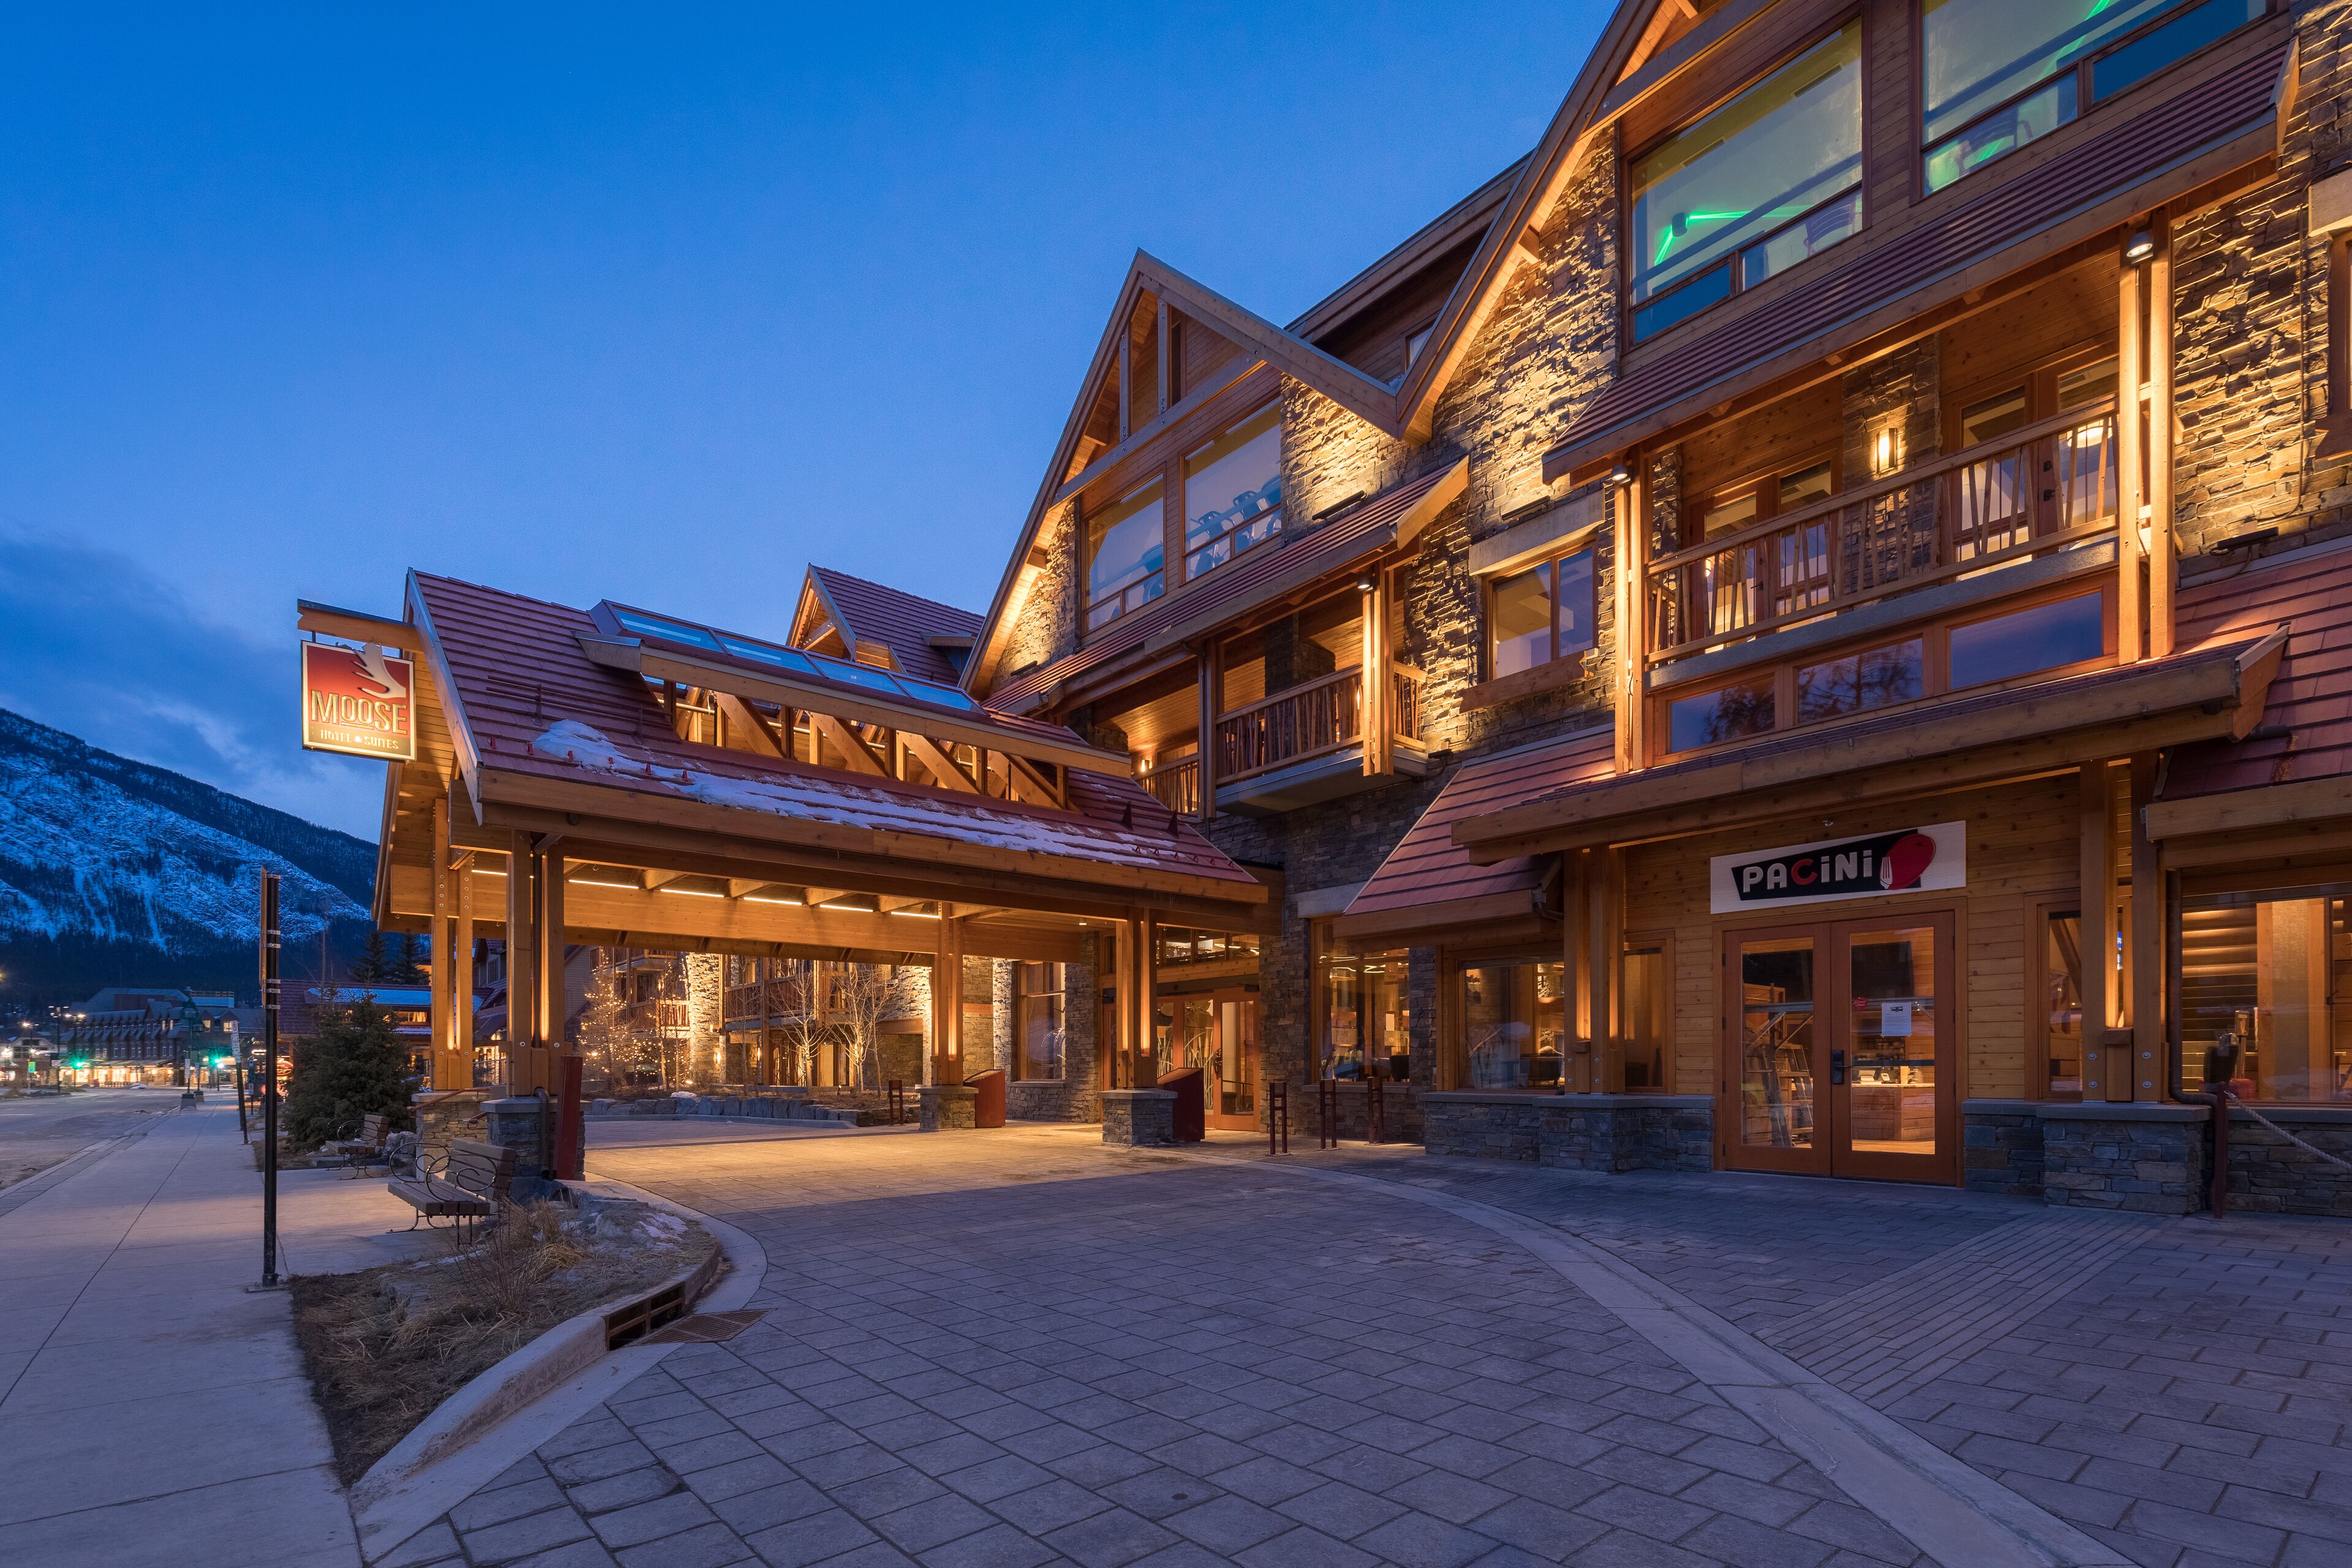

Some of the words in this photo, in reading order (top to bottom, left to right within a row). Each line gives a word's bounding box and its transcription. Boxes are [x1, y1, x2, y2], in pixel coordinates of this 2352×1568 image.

[311, 690, 407, 735] MOOSE
[320, 729, 352, 742] HOTEL
[364, 736, 399, 749] SUITES
